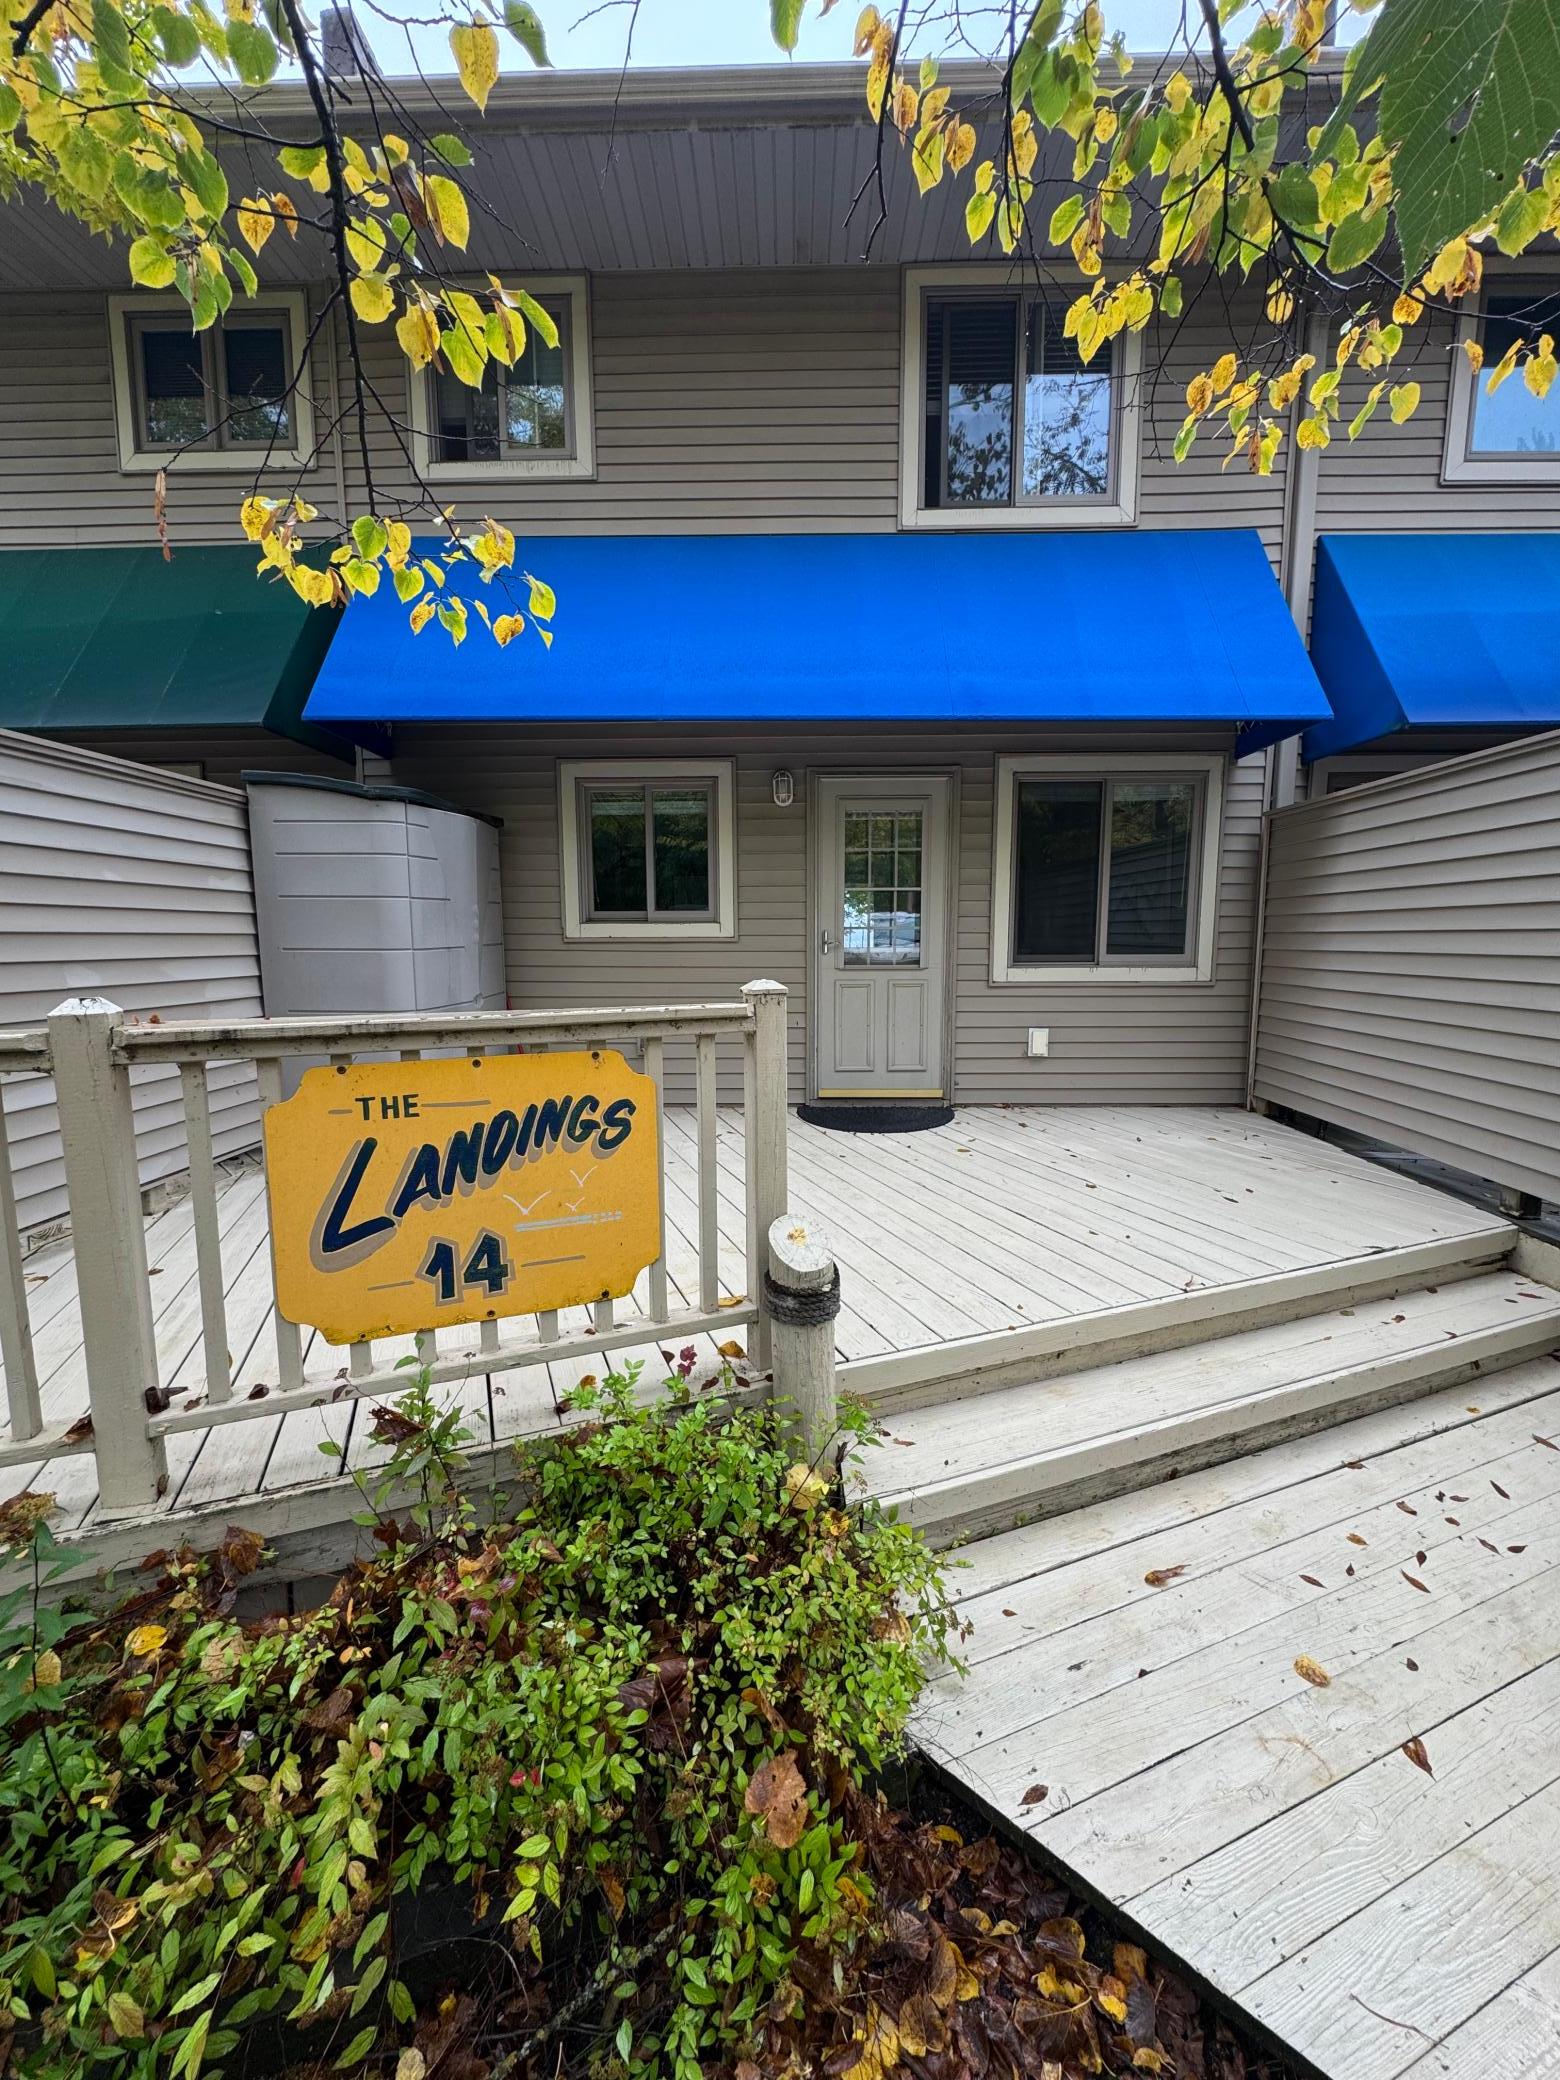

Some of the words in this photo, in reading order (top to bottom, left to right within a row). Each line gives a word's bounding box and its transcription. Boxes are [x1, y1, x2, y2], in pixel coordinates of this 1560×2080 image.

[355, 1093, 421, 1121] THE
[321, 1094, 637, 1254] LANDINGS
[424, 1232, 509, 1300] 14
